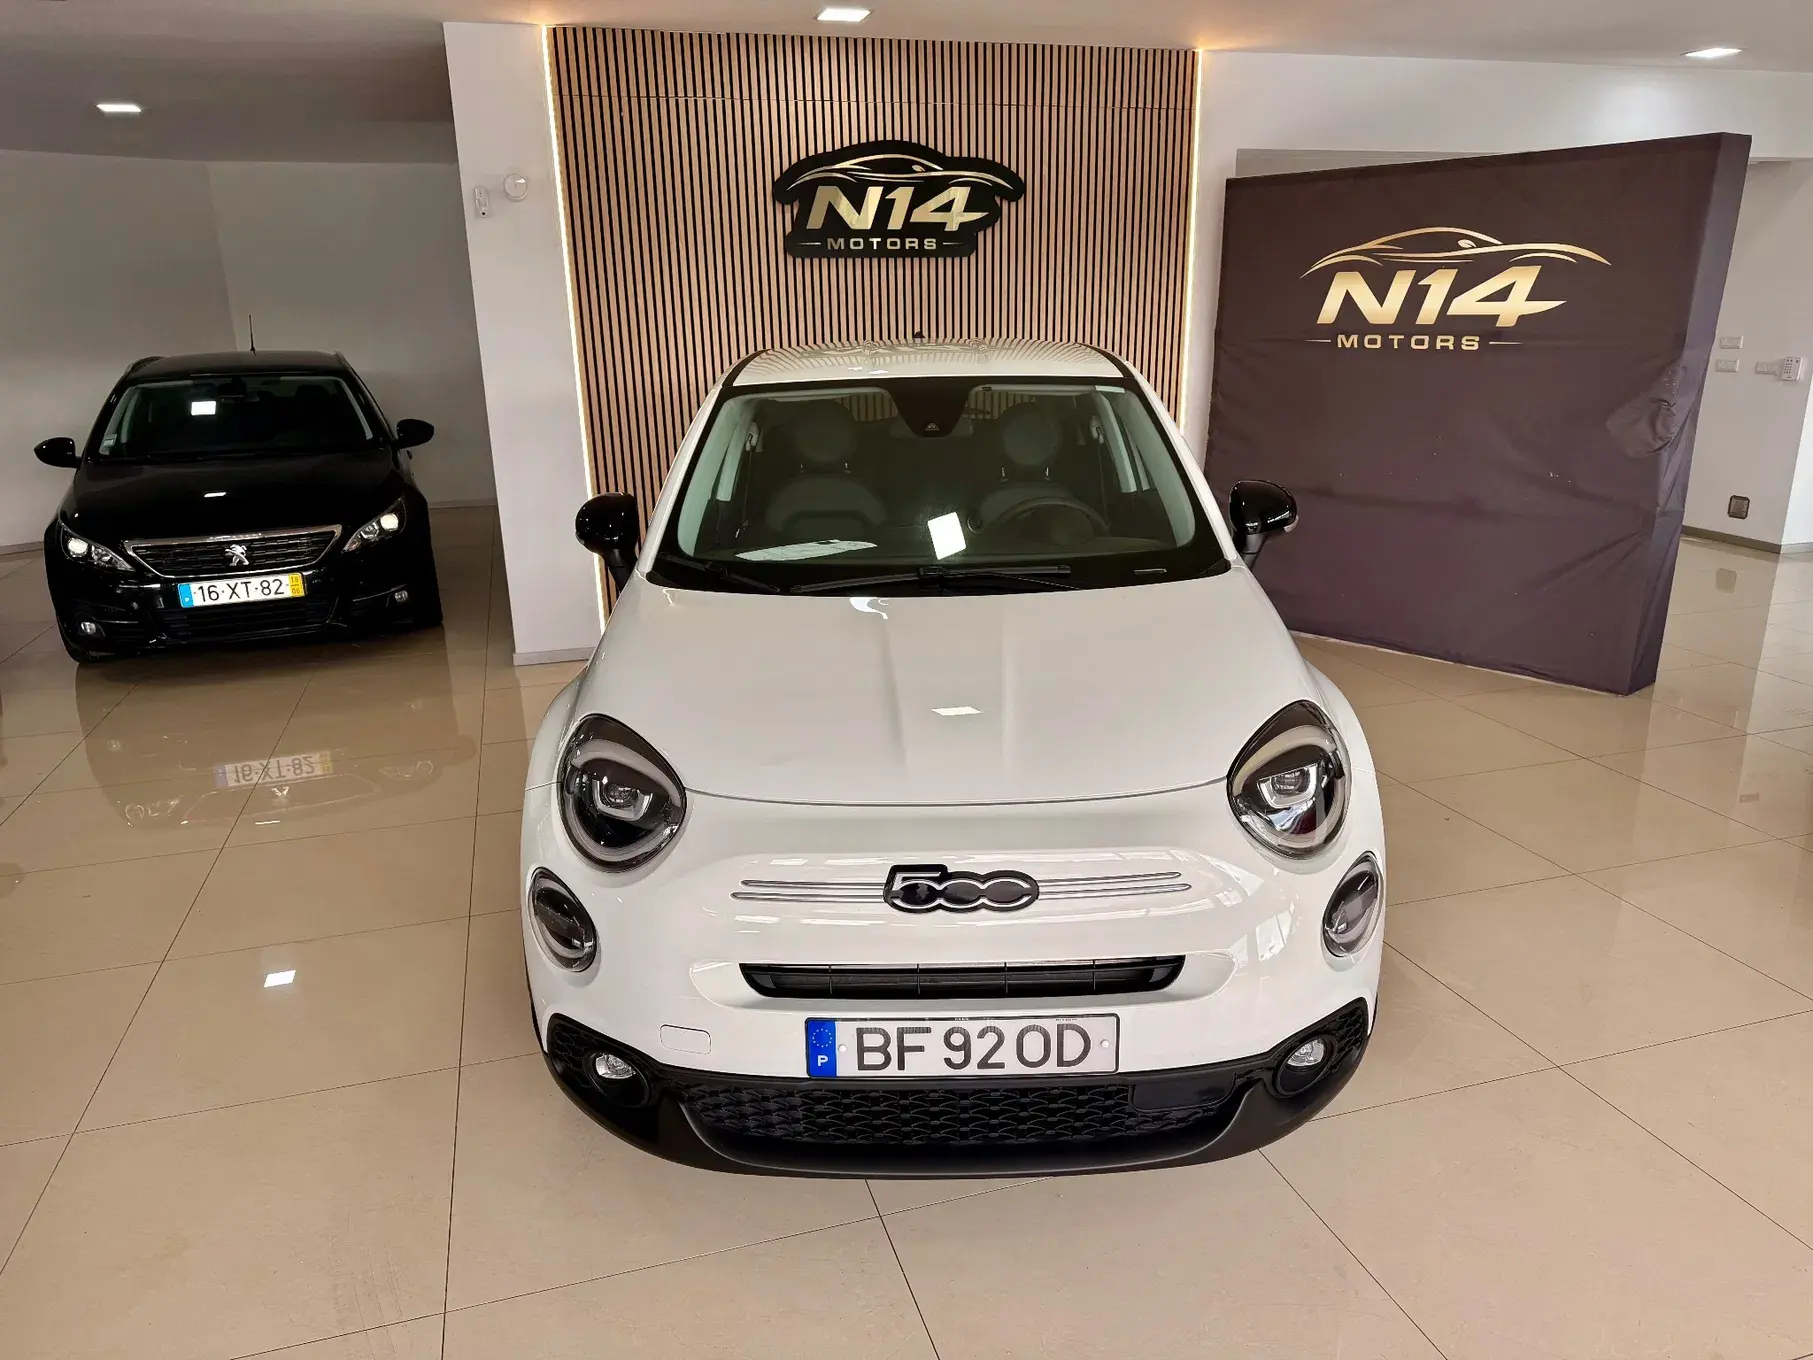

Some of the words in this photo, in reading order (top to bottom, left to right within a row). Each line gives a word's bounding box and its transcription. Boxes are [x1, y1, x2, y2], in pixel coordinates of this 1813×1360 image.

[805, 186, 989, 231] N14
[826, 237, 937, 250] MOTORS
[1316, 265, 1567, 328] N14
[1336, 334, 1480, 350] MOTORS
[884, 864, 1039, 913] 500
[817, 1054, 829, 1067] P
[855, 1026, 932, 1071] BF
[943, 1025, 1006, 1070] 92
[1015, 1023, 1092, 1068] OD
